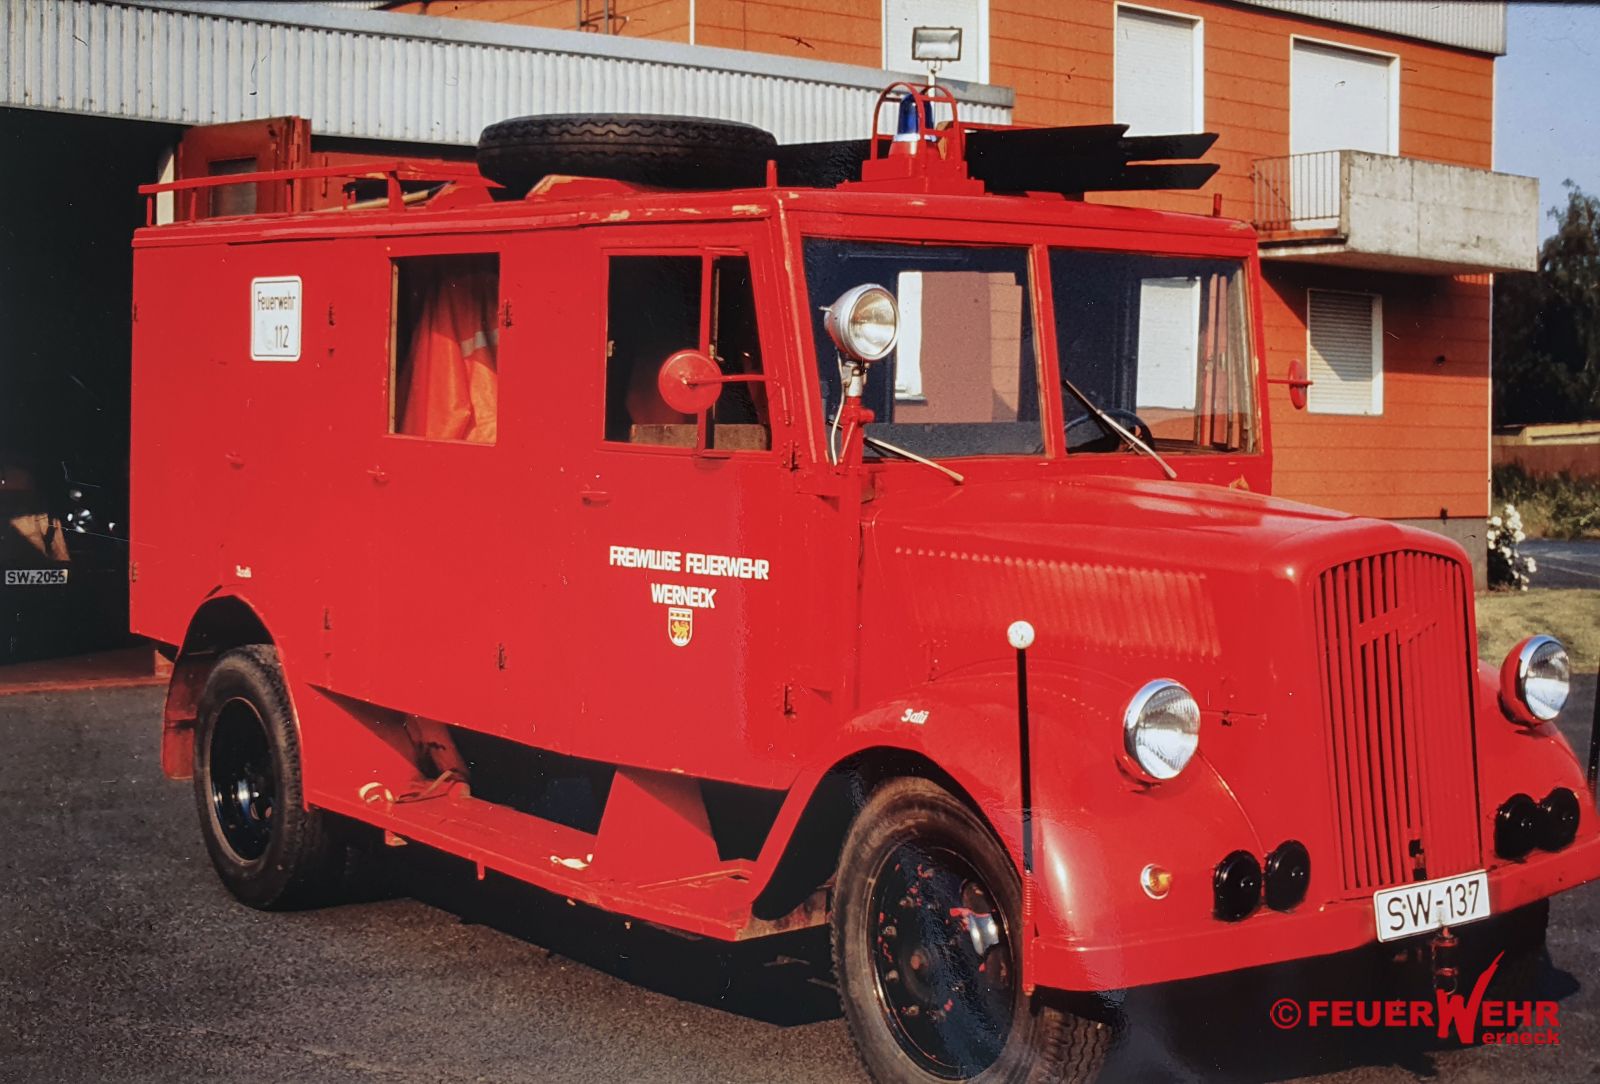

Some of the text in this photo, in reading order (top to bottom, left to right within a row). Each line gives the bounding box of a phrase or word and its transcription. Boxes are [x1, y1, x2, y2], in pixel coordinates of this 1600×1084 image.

[257, 290, 296, 310] Feuerwehr
[274, 324, 290, 349] 112
[609, 545, 769, 580] FREIWILLIGE FEUERWEHR
[650, 582, 717, 608] WERNECK
